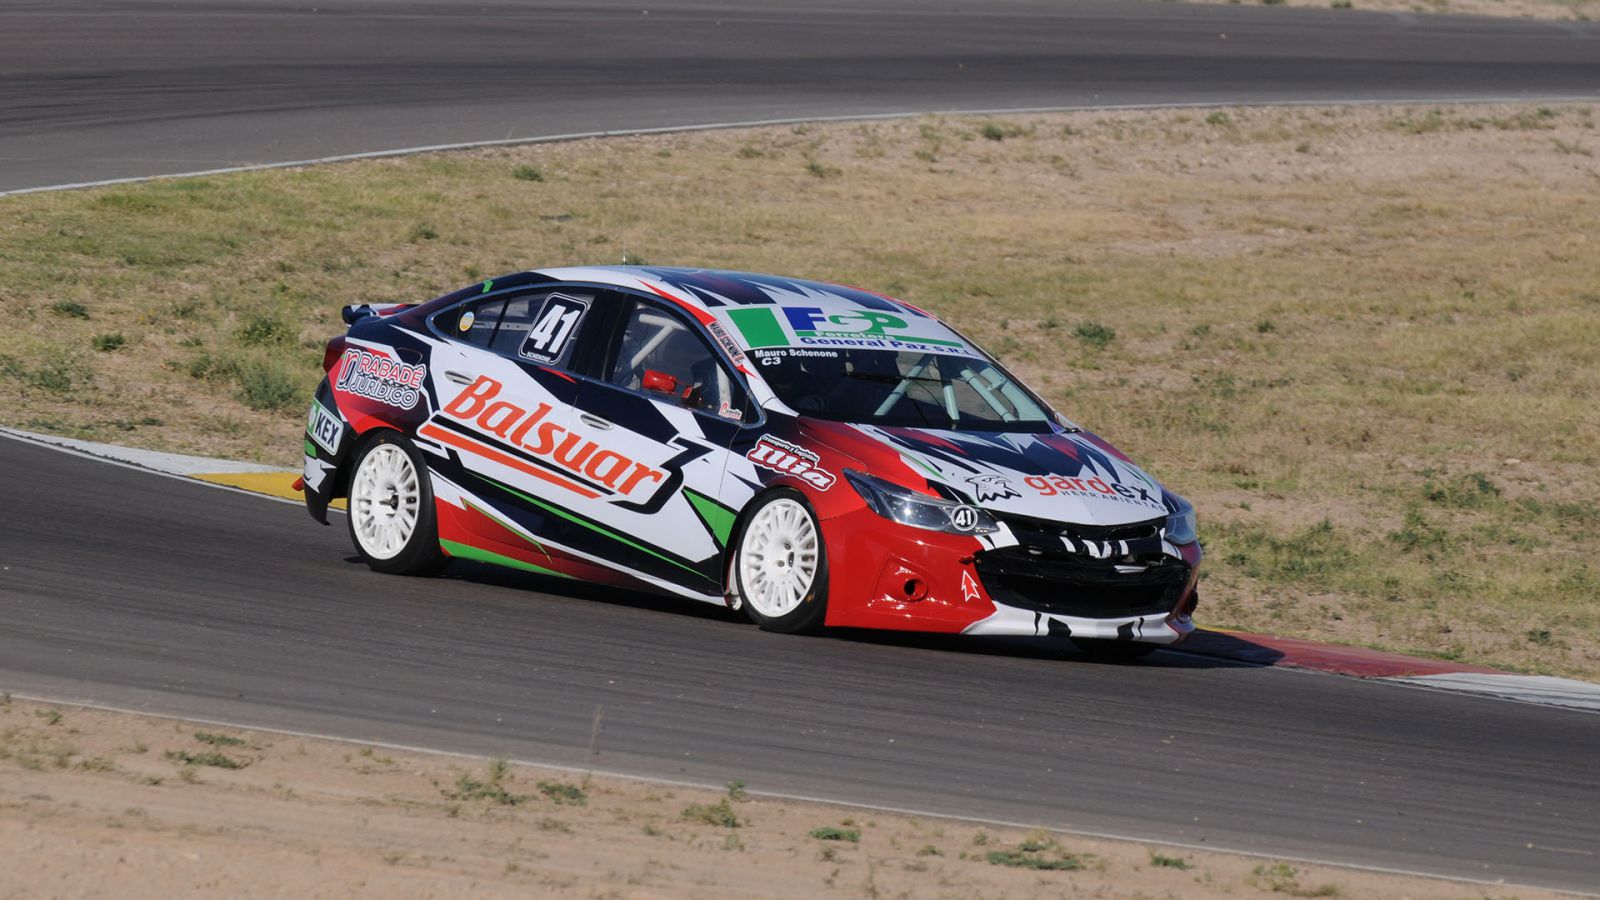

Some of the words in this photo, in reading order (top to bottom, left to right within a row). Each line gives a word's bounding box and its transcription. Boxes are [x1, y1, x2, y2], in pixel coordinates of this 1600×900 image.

[530, 304, 580, 354] 41
[781, 306, 908, 333] FGP
[754, 349, 787, 358] Mauro
[789, 349, 838, 358] Schenone
[800, 338, 886, 348] General
[890, 340, 930, 351] Paz
[359, 356, 425, 387] RABADÉ
[761, 357, 781, 366] C3
[443, 374, 664, 496] Balsuar
[1023, 475, 1160, 505] gardex
[1061, 489, 1166, 513] HERRAMIENTAS
[955, 510, 971, 526] 41
